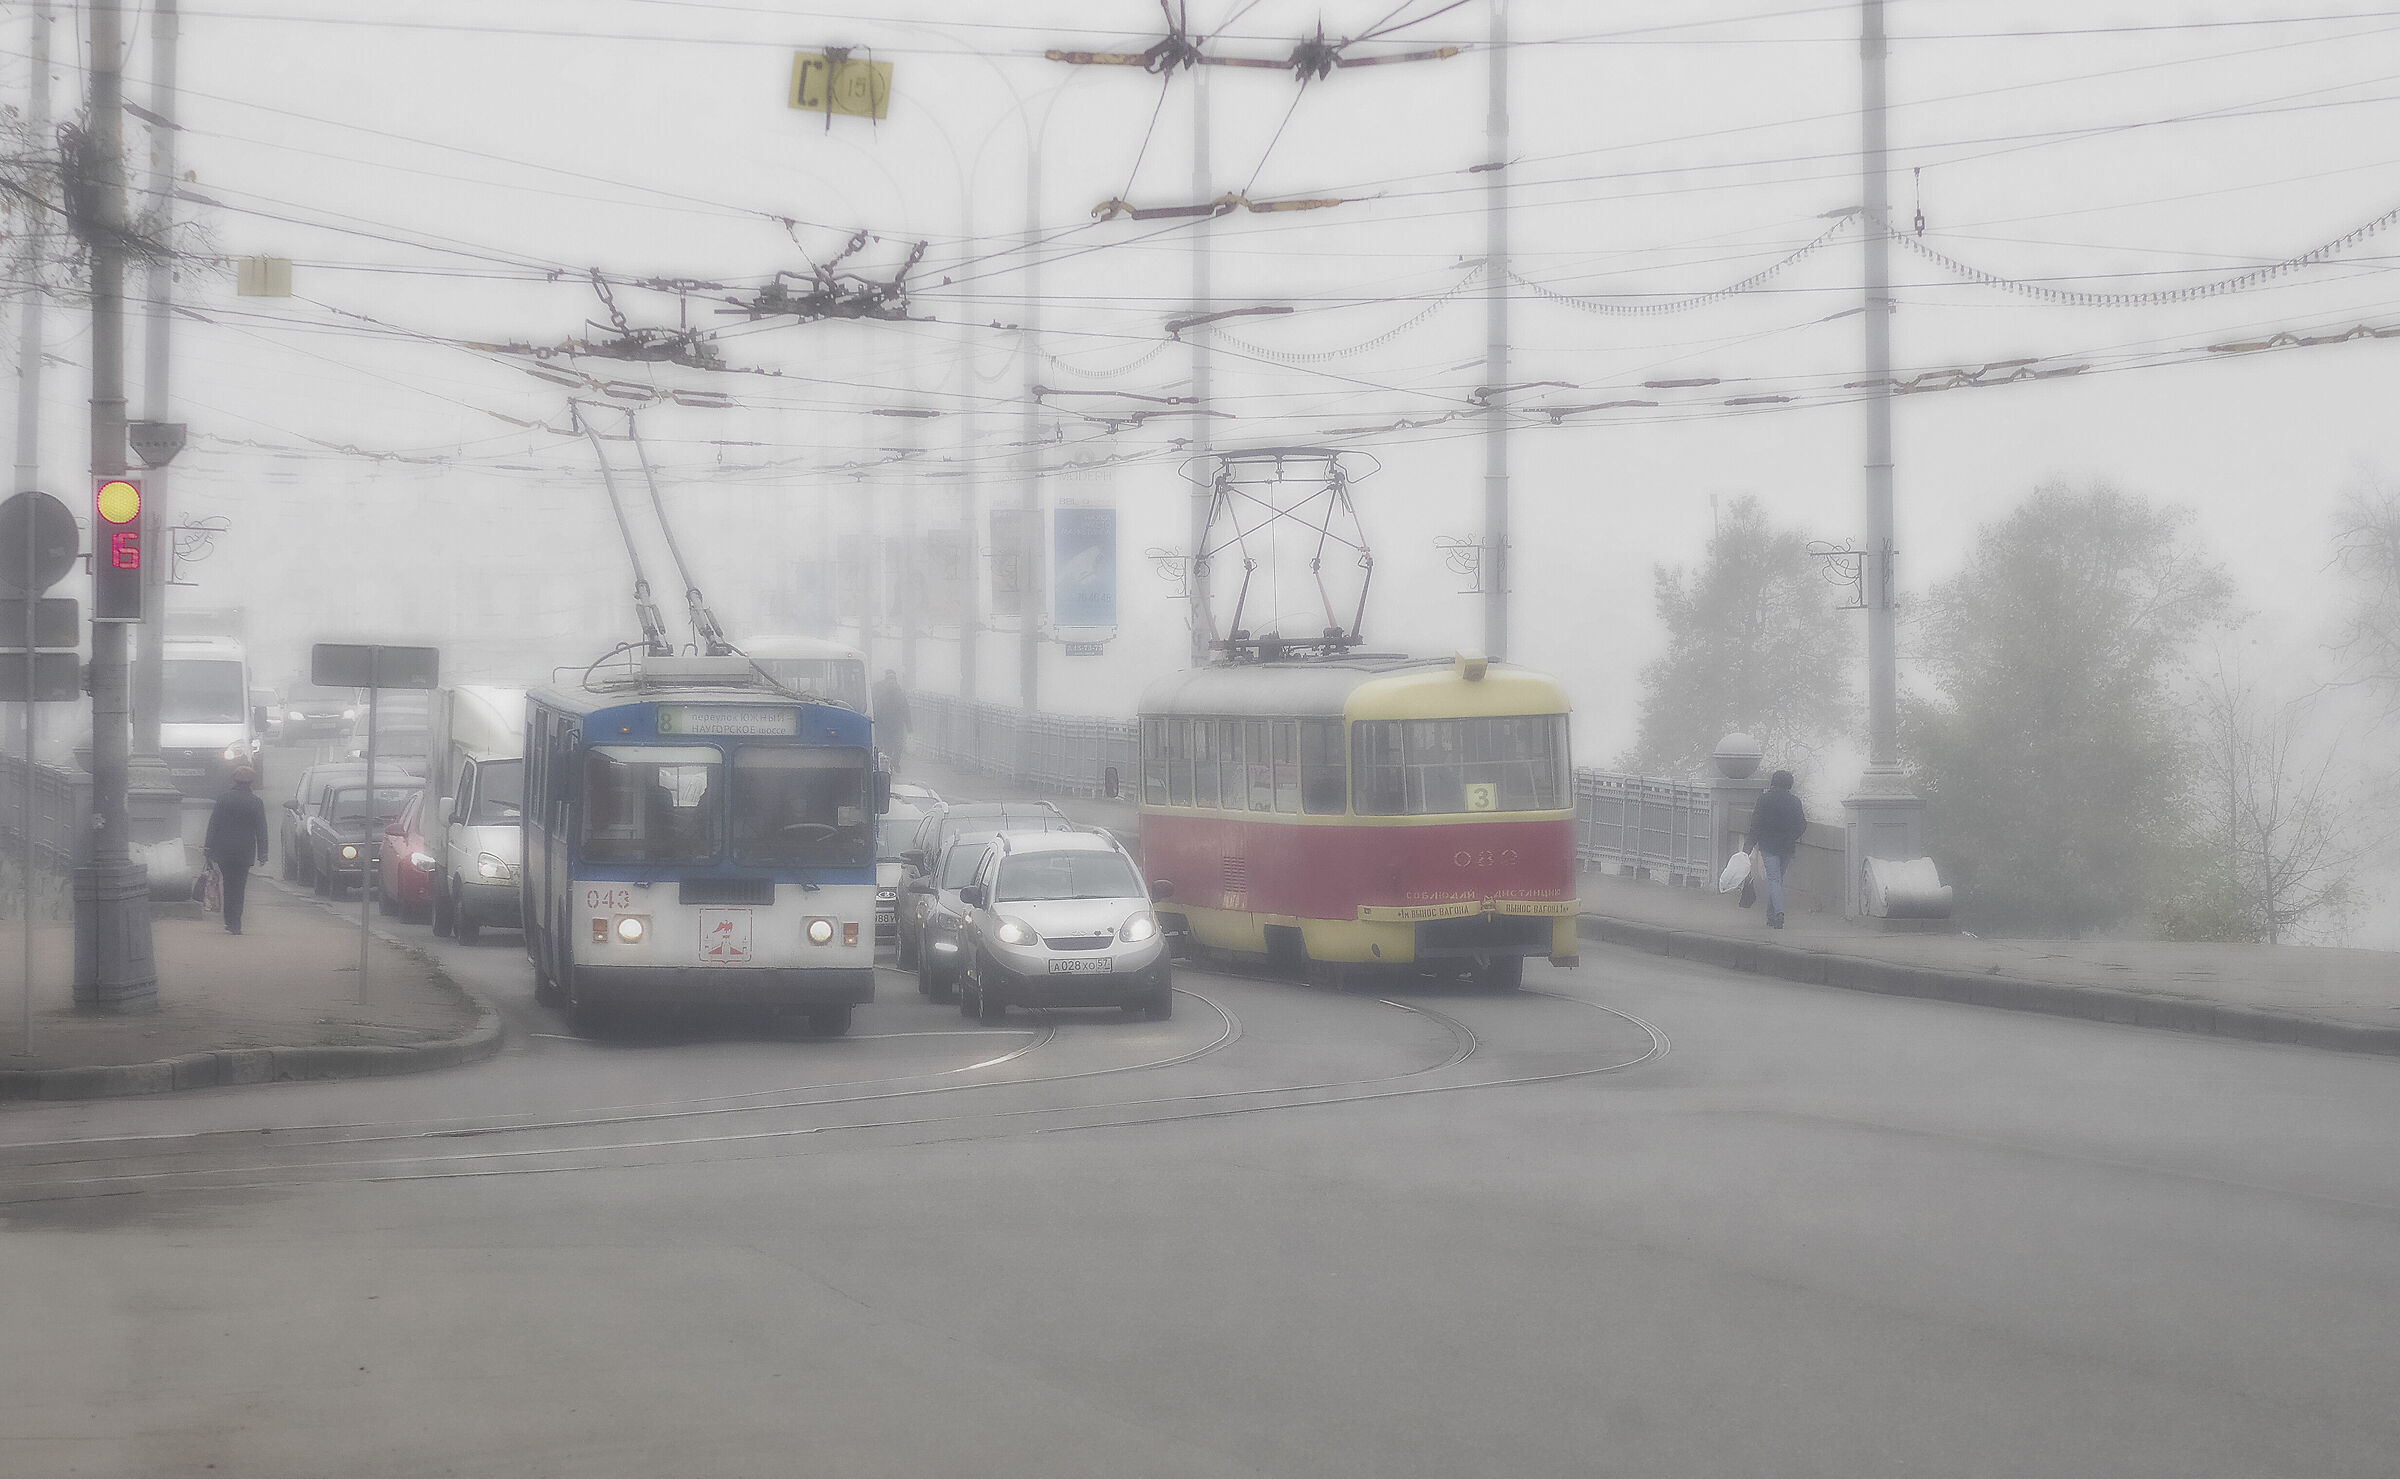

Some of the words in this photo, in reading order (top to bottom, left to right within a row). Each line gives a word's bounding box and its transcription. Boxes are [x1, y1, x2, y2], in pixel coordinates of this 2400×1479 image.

[112, 532, 140, 569] 6
[659, 713, 672, 732] 8
[692, 726, 755, 734] НАУГОРСКОЕ
[758, 727, 786, 735] шоссе
[1474, 787, 1489, 809] 3
[587, 890, 629, 908] 043
[1406, 889, 1475, 900] СОБЛЮДАЙ
[1411, 909, 1437, 918] ВЫНОС
[1439, 905, 1469, 915] ВАГОНА
[1505, 904, 1531, 912] ВЫНОС
